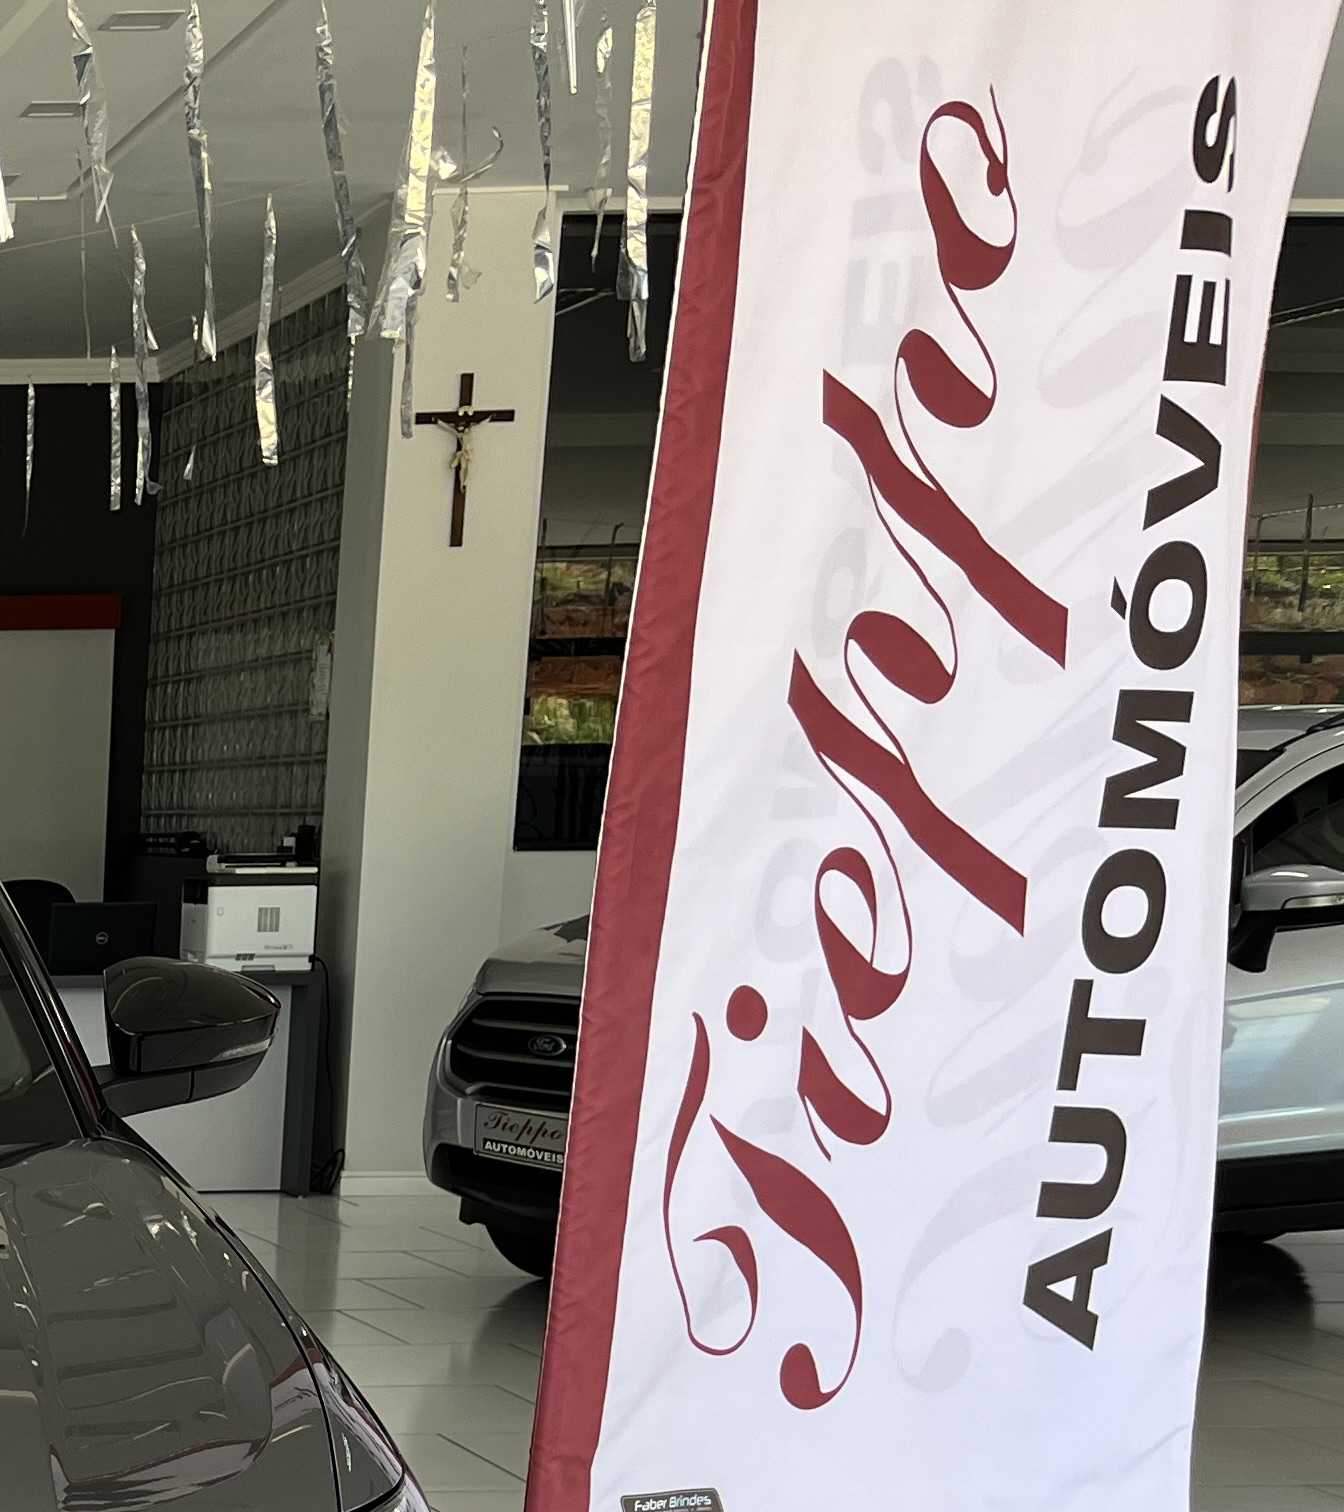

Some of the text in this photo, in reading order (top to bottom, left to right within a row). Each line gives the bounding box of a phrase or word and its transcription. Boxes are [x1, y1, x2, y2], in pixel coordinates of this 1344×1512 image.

[661, 84, 1070, 1411] Tieppo
[1021, 74, 1239, 1352] AUTOMÓVEIS
[483, 1110, 562, 1145] Tieppo
[634, 1498, 667, 1512] Faber
[669, 1493, 712, 1508] Brindes
